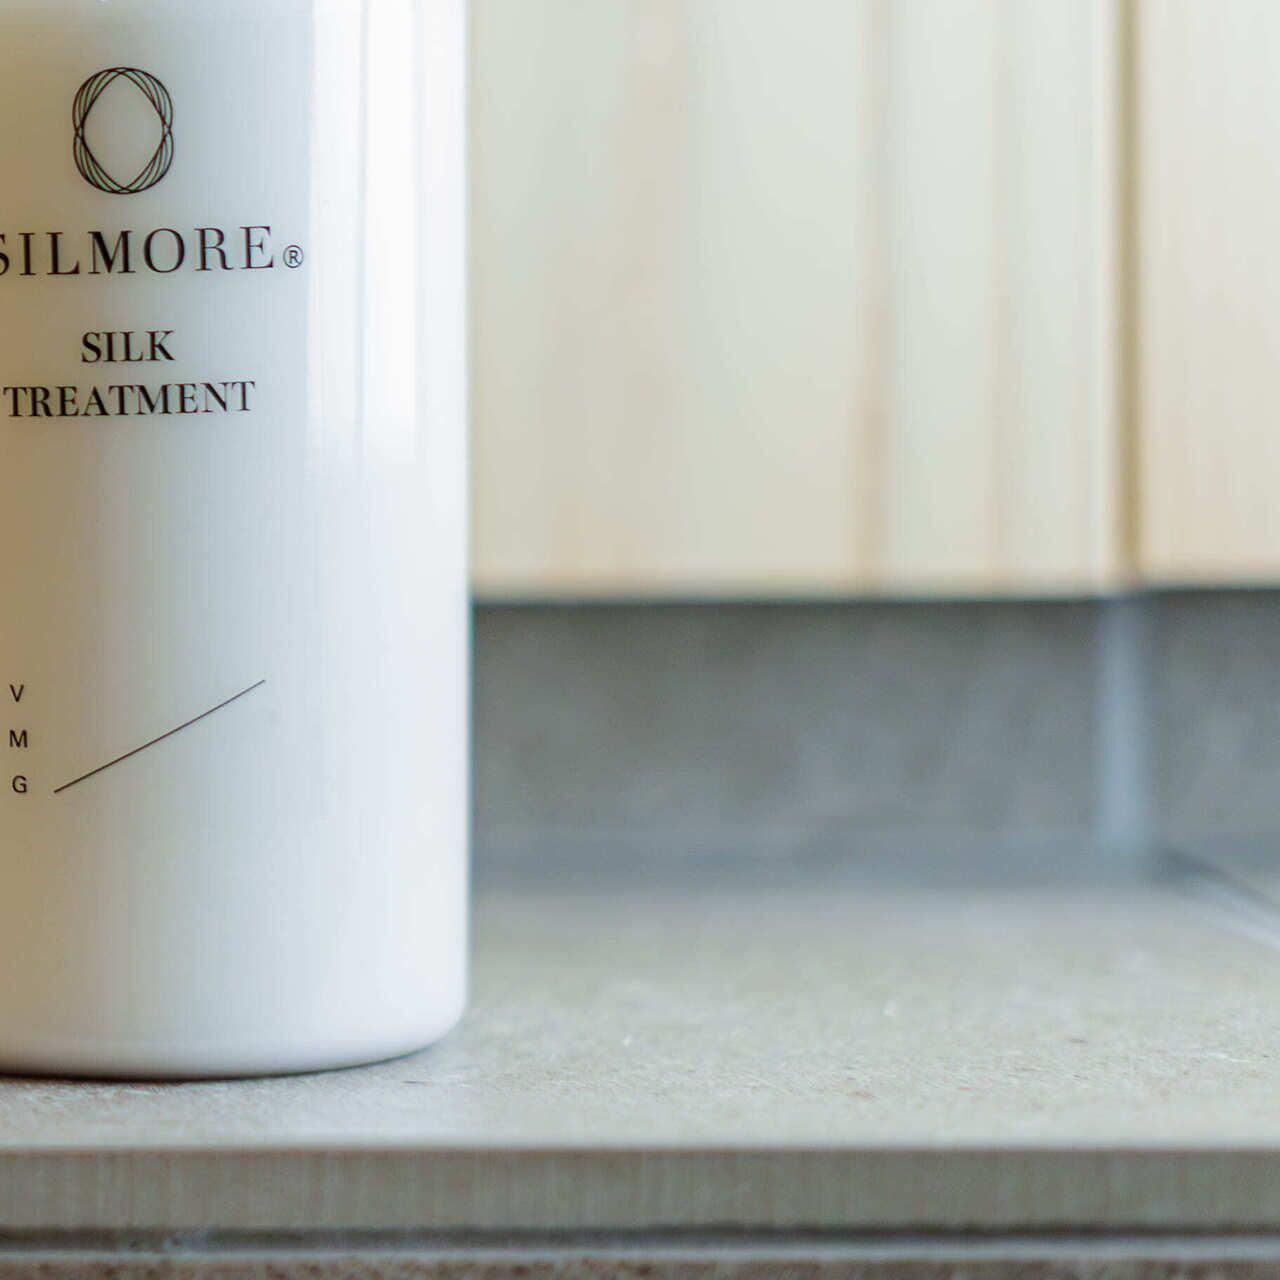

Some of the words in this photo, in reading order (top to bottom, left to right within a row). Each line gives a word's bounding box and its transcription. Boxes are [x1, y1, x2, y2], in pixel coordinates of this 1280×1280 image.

[81, 330, 176, 364] SILK
[2, 380, 256, 418] TREATMENT
[9, 684, 25, 703] V
[9, 730, 28, 749] M
[12, 775, 28, 794] G
